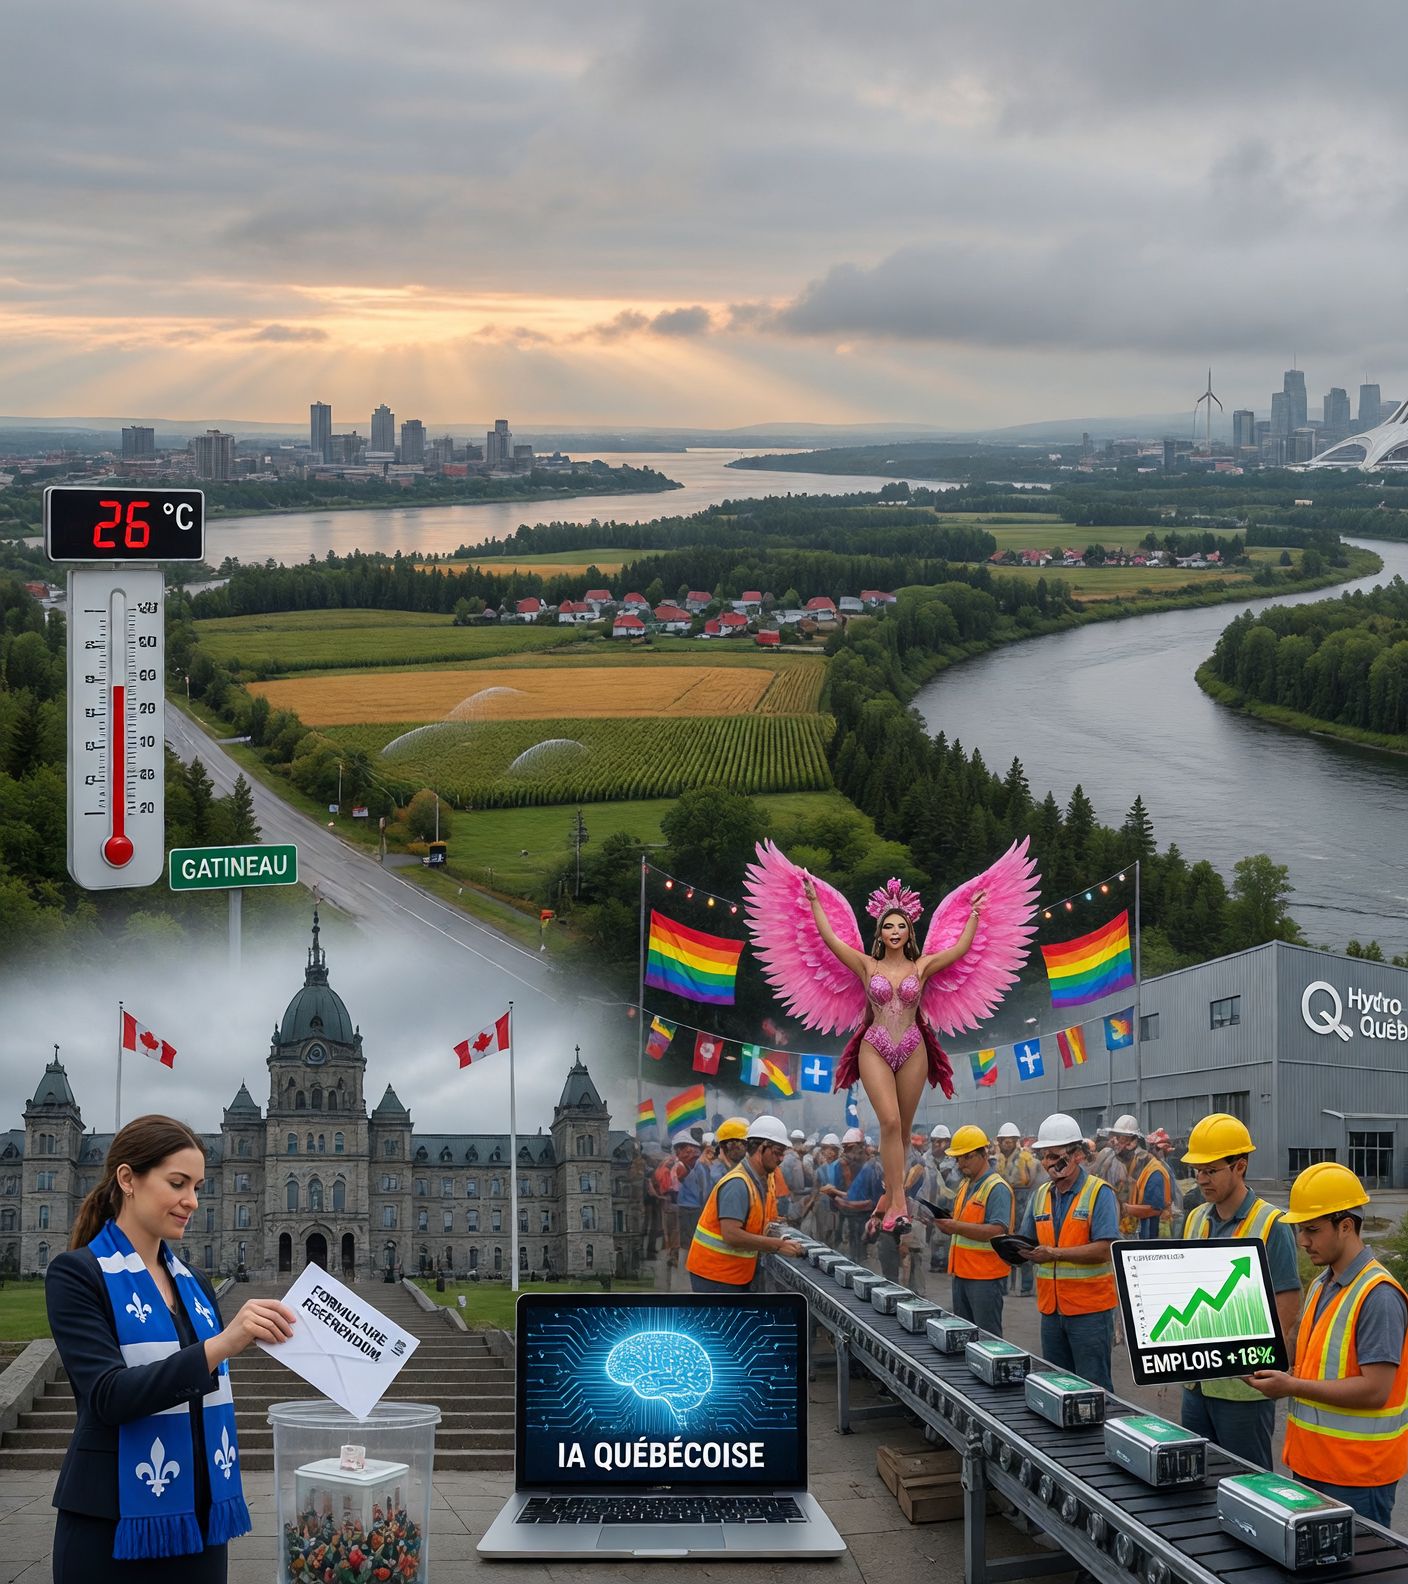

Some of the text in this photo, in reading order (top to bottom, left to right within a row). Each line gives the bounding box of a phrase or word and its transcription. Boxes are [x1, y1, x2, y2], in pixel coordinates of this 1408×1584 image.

[93, 501, 195, 549] 26 °C
[182, 855, 288, 880] GATINEAU
[1348, 987, 1402, 1015] Hydro
[1141, 1346, 1276, 1375] EMPLOIS +18%
[558, 1435, 765, 1471] IA QUÉBÉCOISE
